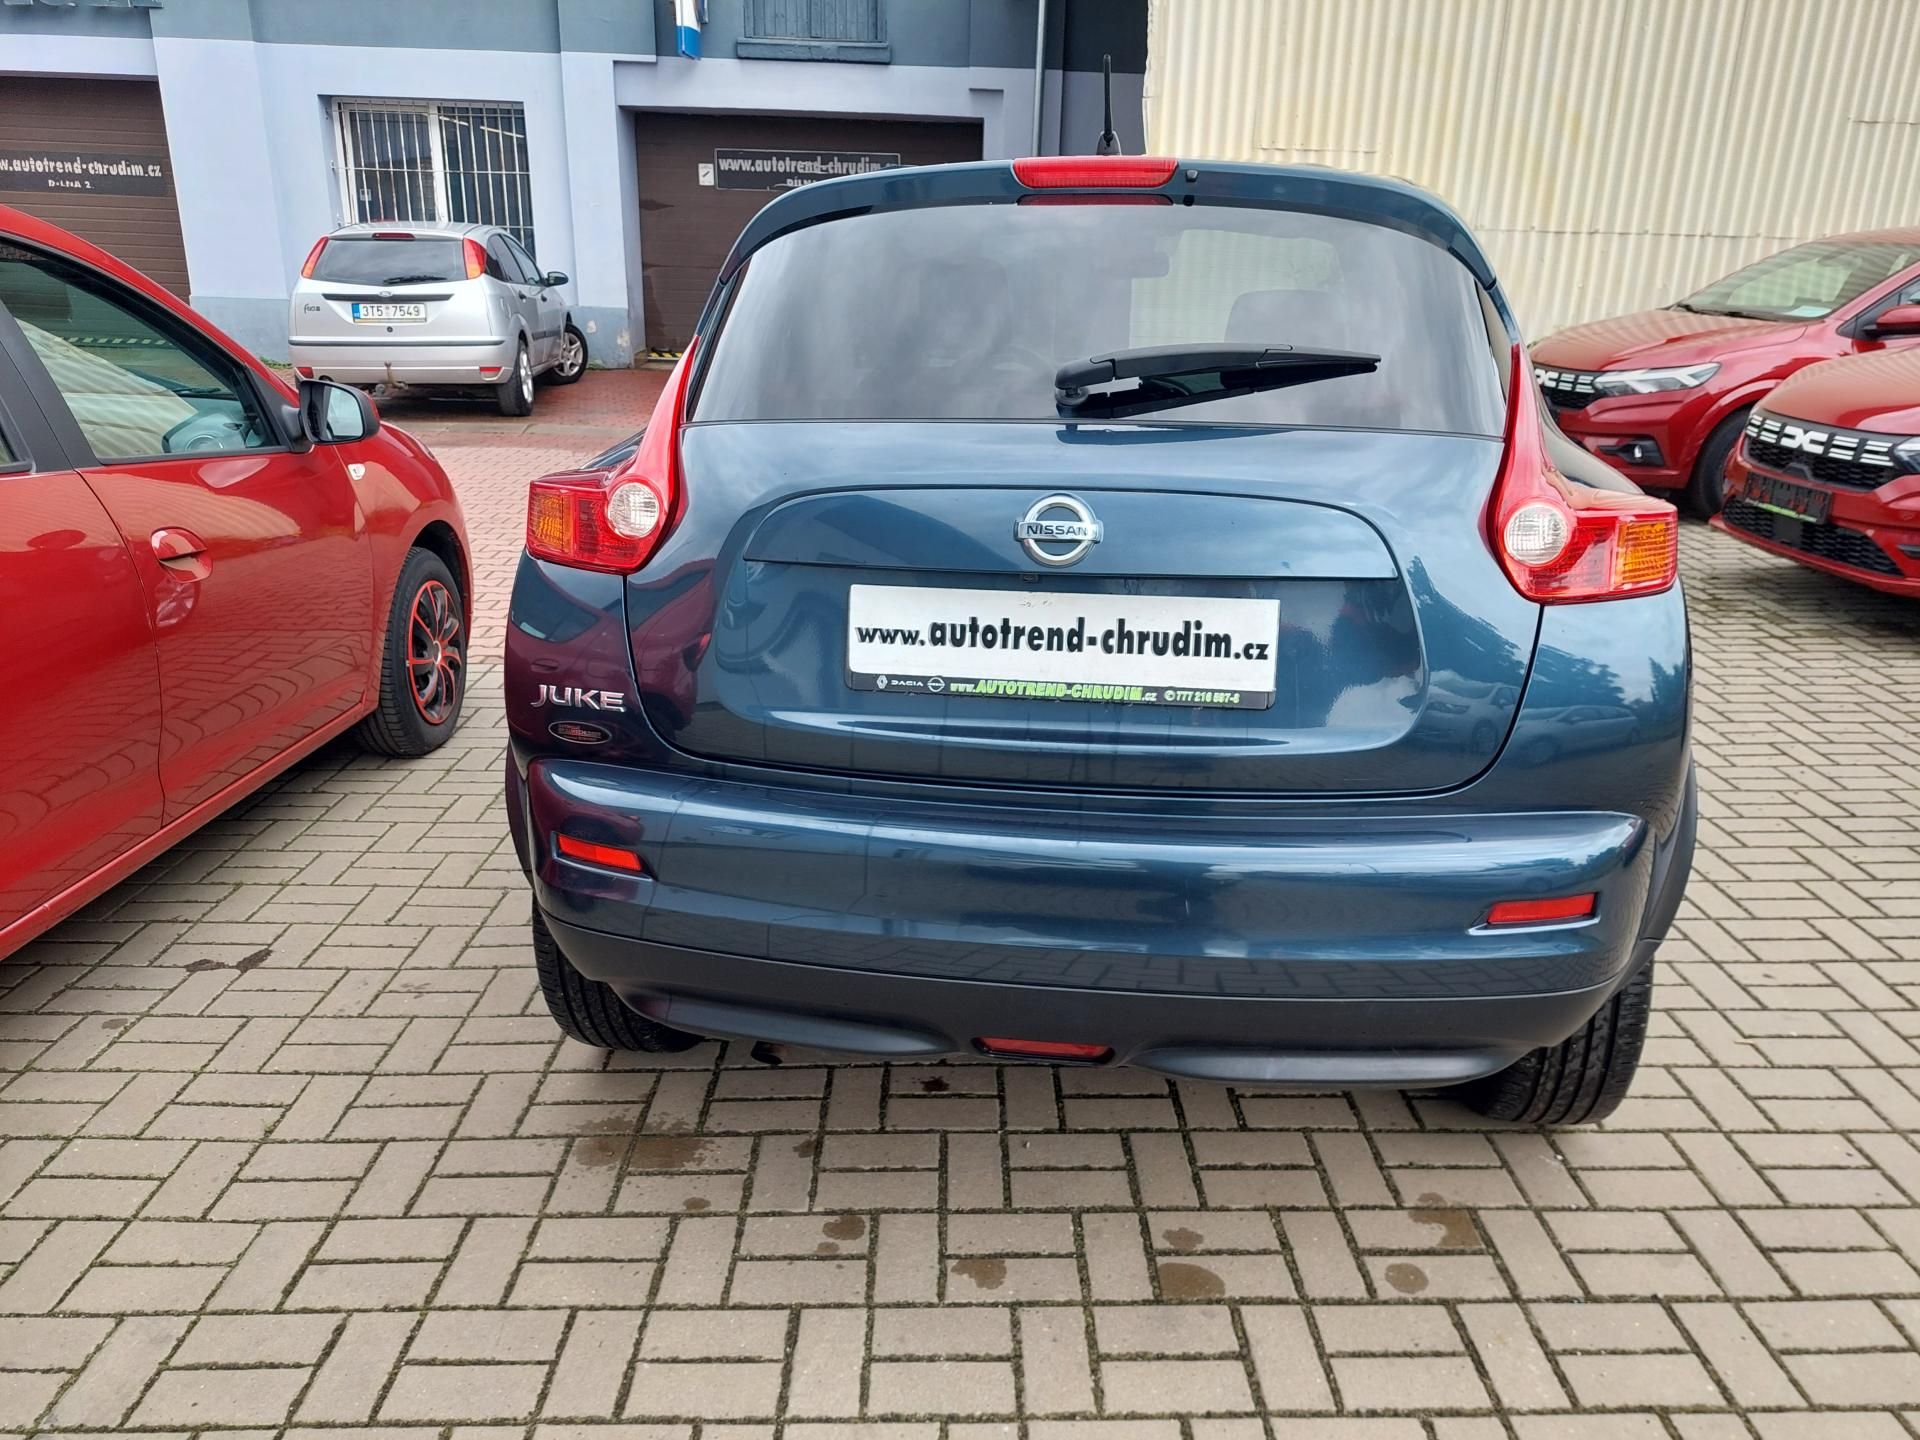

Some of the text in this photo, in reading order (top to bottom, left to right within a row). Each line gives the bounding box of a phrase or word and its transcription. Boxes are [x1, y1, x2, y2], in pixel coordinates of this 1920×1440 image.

[718, 155, 899, 175] www.autotrend-chrudim.
[362, 306, 383, 317] 3T5
[392, 306, 420, 317] 7549
[1026, 525, 1087, 536] NISSAN
[856, 616, 1269, 660] www.autotrend-chrudim.cz
[530, 684, 626, 712] JUKE
